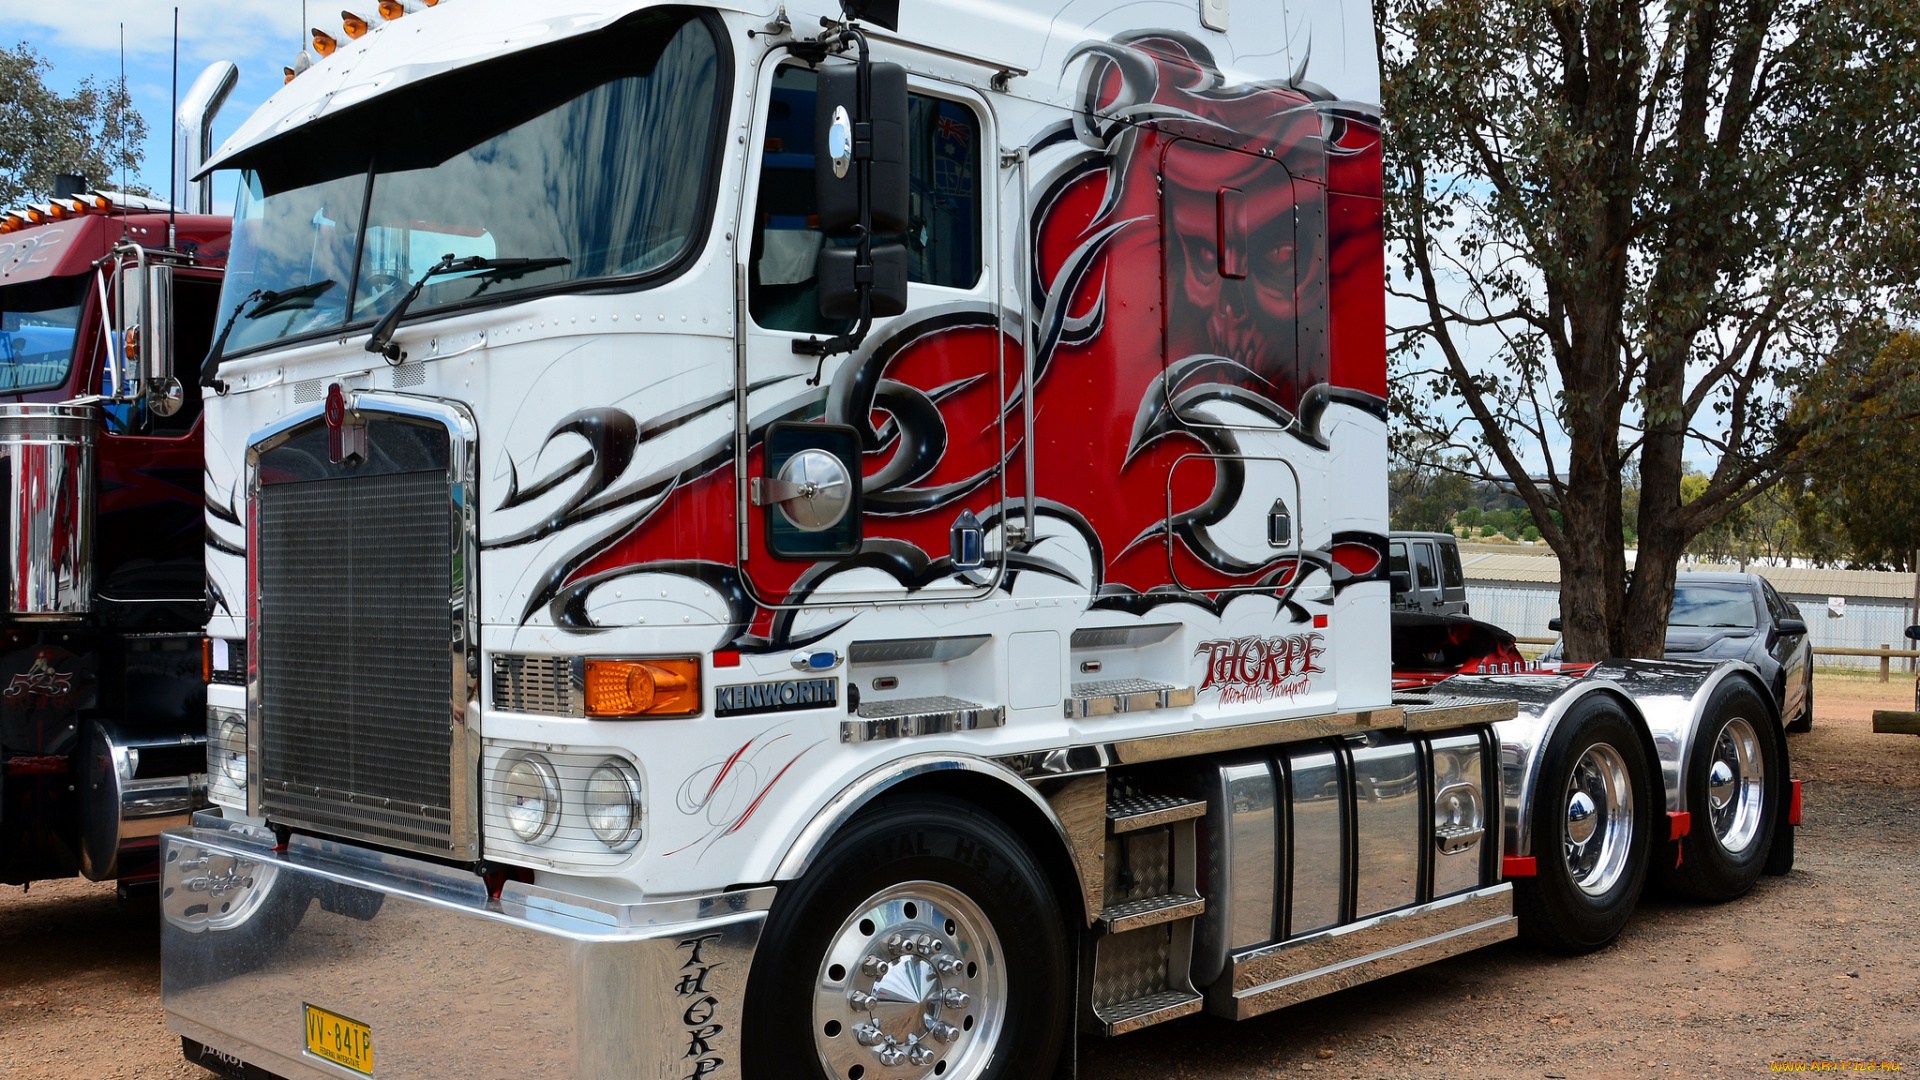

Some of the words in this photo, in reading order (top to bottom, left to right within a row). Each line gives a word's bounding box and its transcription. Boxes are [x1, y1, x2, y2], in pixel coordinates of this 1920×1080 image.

[1194, 632, 1326, 695] THORPE
[3, 672, 73, 697] 525
[716, 679, 836, 711] KENWORTH
[320, 1045, 336, 1059] FEDERAL
[337, 1054, 360, 1069] INTERSTATE
